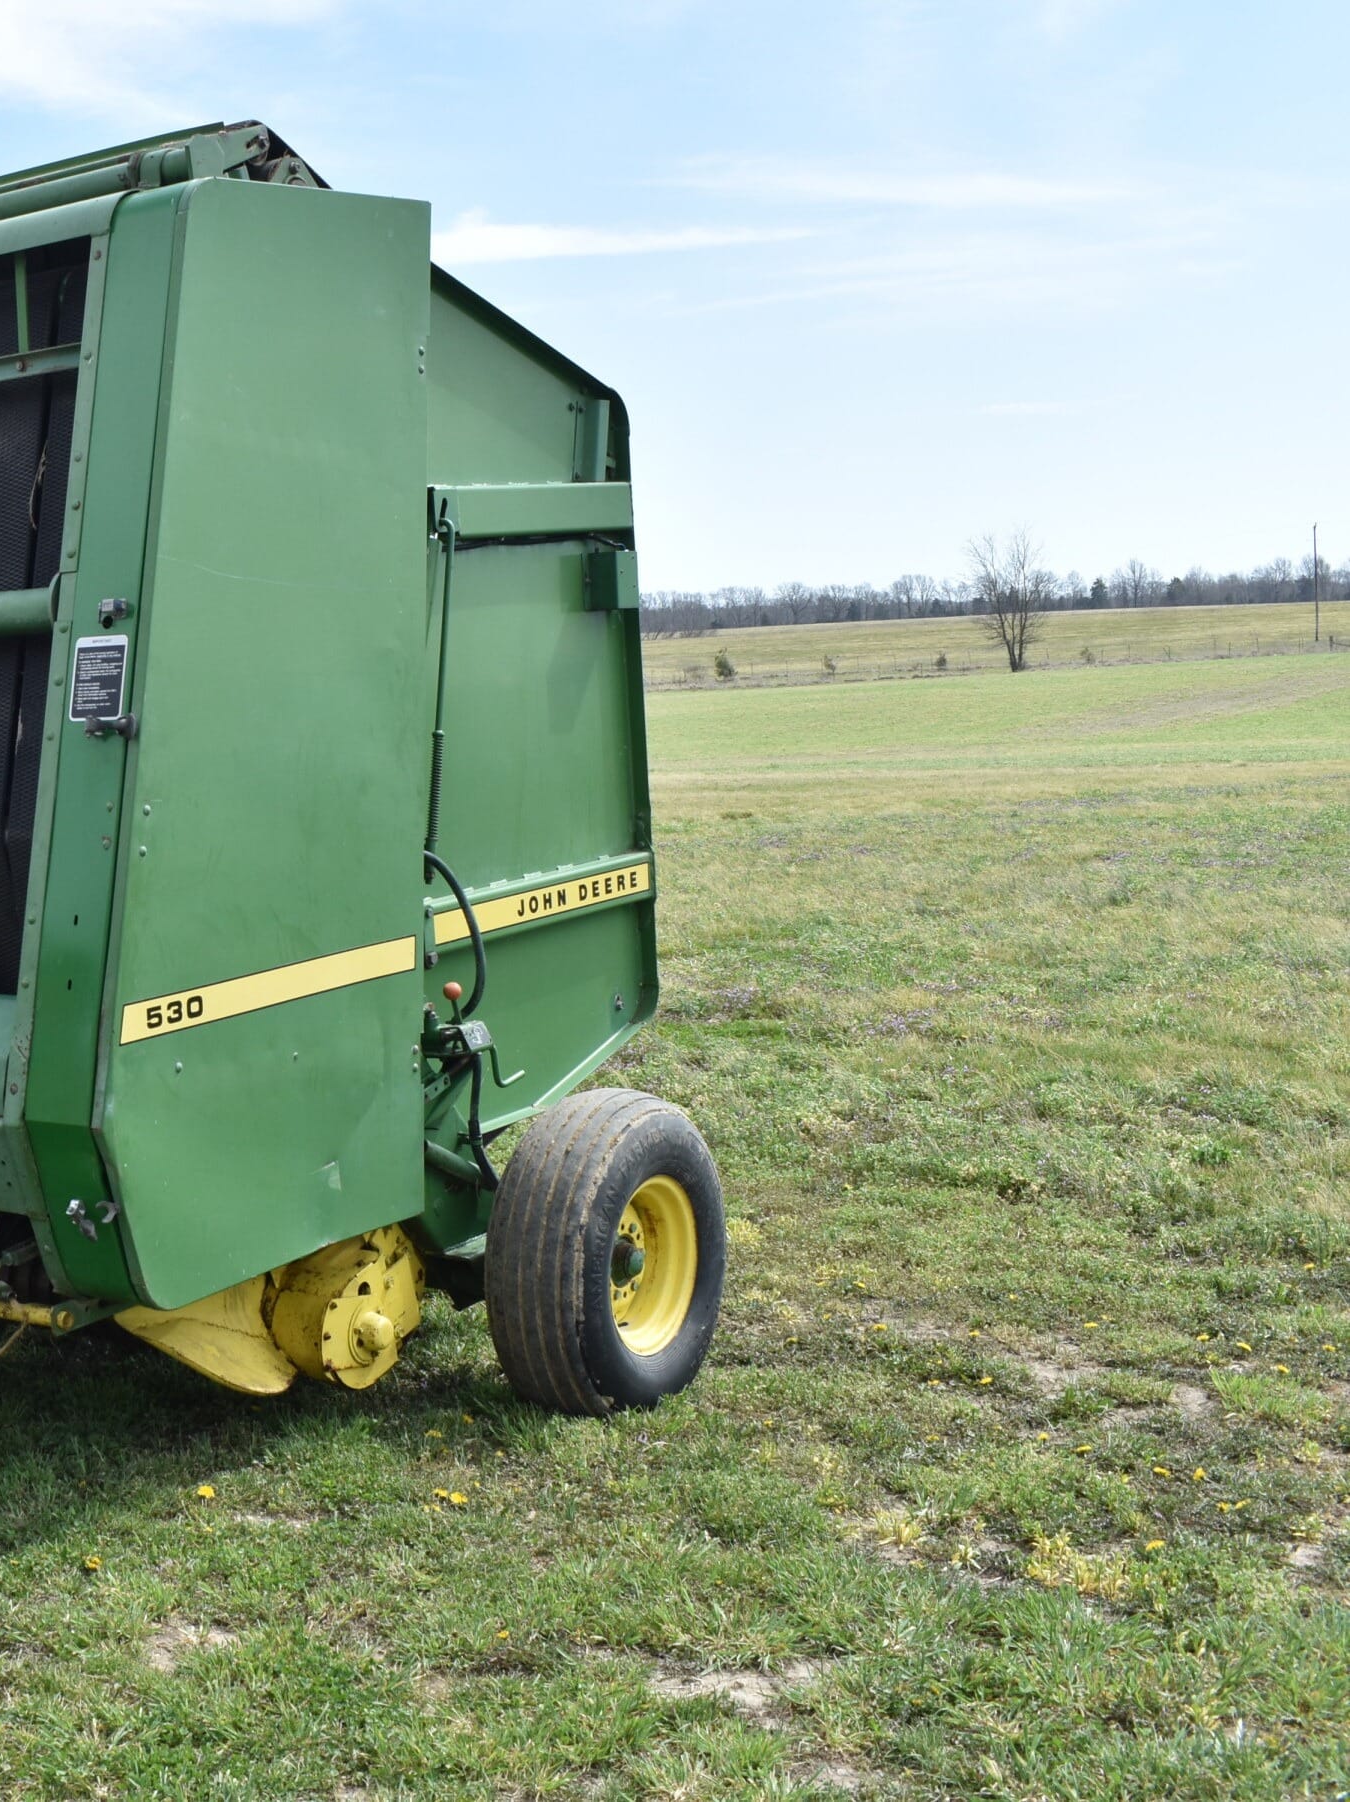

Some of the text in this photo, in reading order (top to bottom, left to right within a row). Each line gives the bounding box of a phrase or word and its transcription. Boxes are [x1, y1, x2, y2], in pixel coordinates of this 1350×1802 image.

[517, 871, 638, 917] JOHN DEERE
[146, 995, 204, 1029] 530
